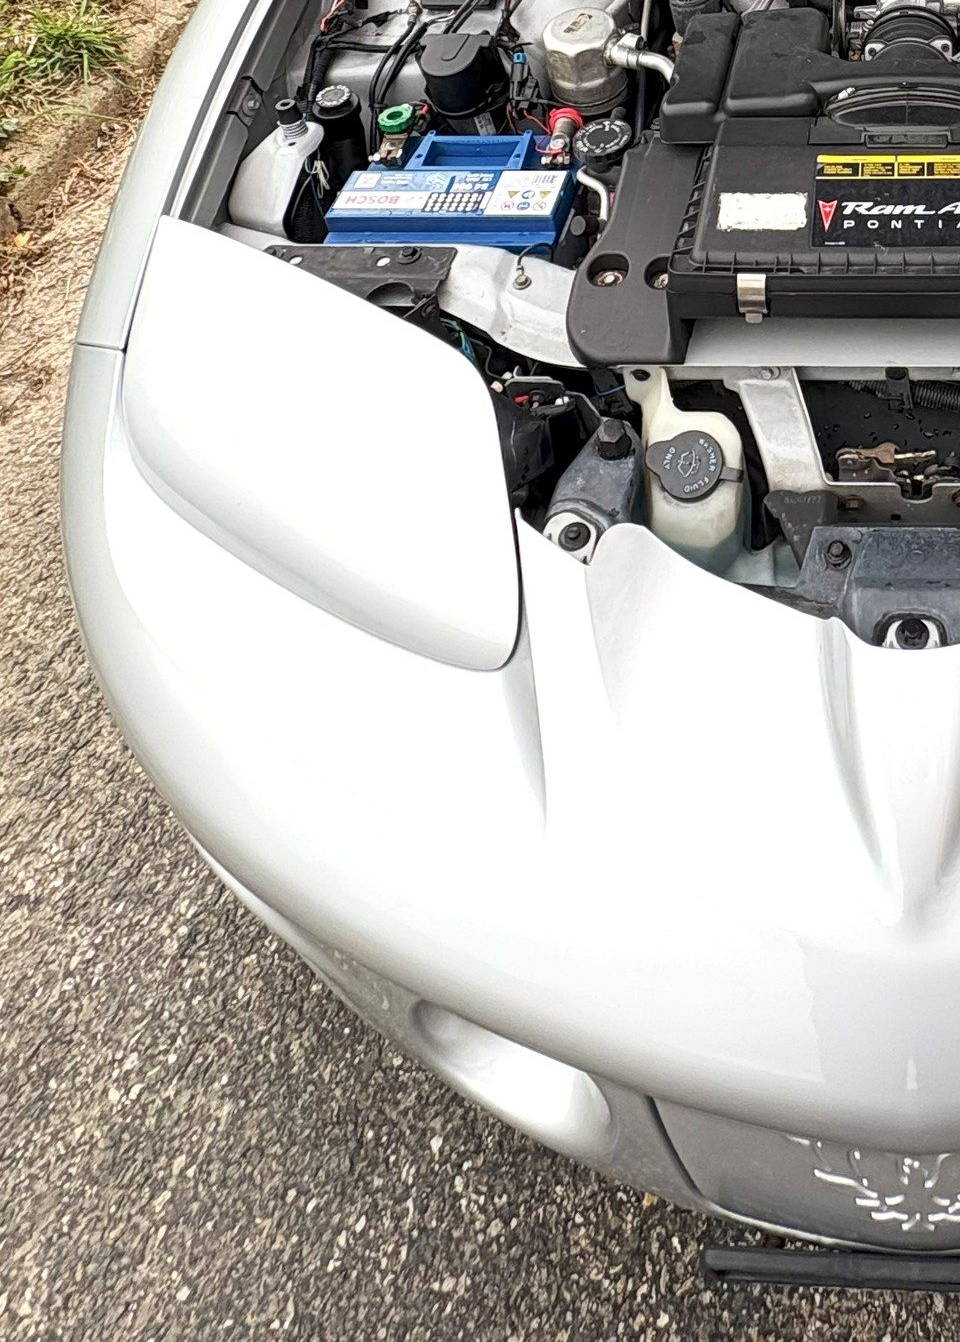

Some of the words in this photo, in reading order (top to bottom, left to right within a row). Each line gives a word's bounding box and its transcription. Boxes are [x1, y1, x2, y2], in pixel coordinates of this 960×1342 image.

[344, 195, 400, 205] BOSCH
[841, 201, 936, 215] Ram
[663, 446, 676, 470] ONLY
[699, 438, 717, 472] WASHER
[683, 476, 710, 493] FLUID
